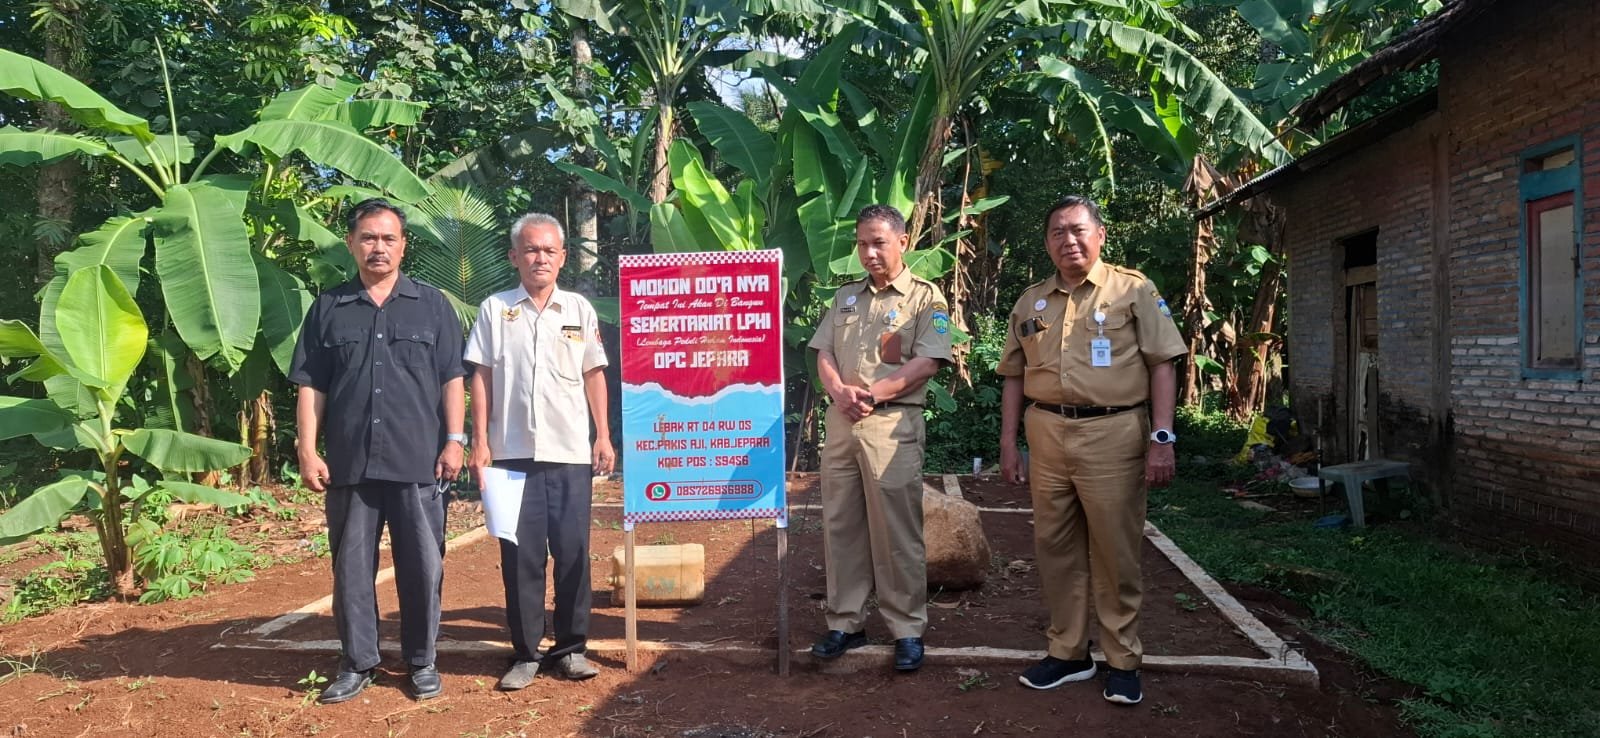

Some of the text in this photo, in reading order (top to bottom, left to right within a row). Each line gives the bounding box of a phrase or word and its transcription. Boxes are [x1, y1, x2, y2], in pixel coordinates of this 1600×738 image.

[630, 278, 691, 296] MOHON
[737, 275, 769, 292] NYA
[637, 300, 669, 311] Tempat
[672, 299, 686, 308] Ini
[688, 298, 712, 308] Akan
[714, 298, 728, 307] Di
[630, 313, 771, 333] SEKERTARIAT LPHI
[690, 350, 749, 367] JEPARA
[653, 421, 684, 433] LEBAK
[687, 421, 699, 432] RT
[703, 421, 715, 431] 04
[719, 421, 735, 431] RW
[636, 439, 687, 451] KEC.PAKIS
[690, 439, 707, 450] AJI,
[657, 457, 683, 468] KODE
[686, 456, 706, 467] POS
